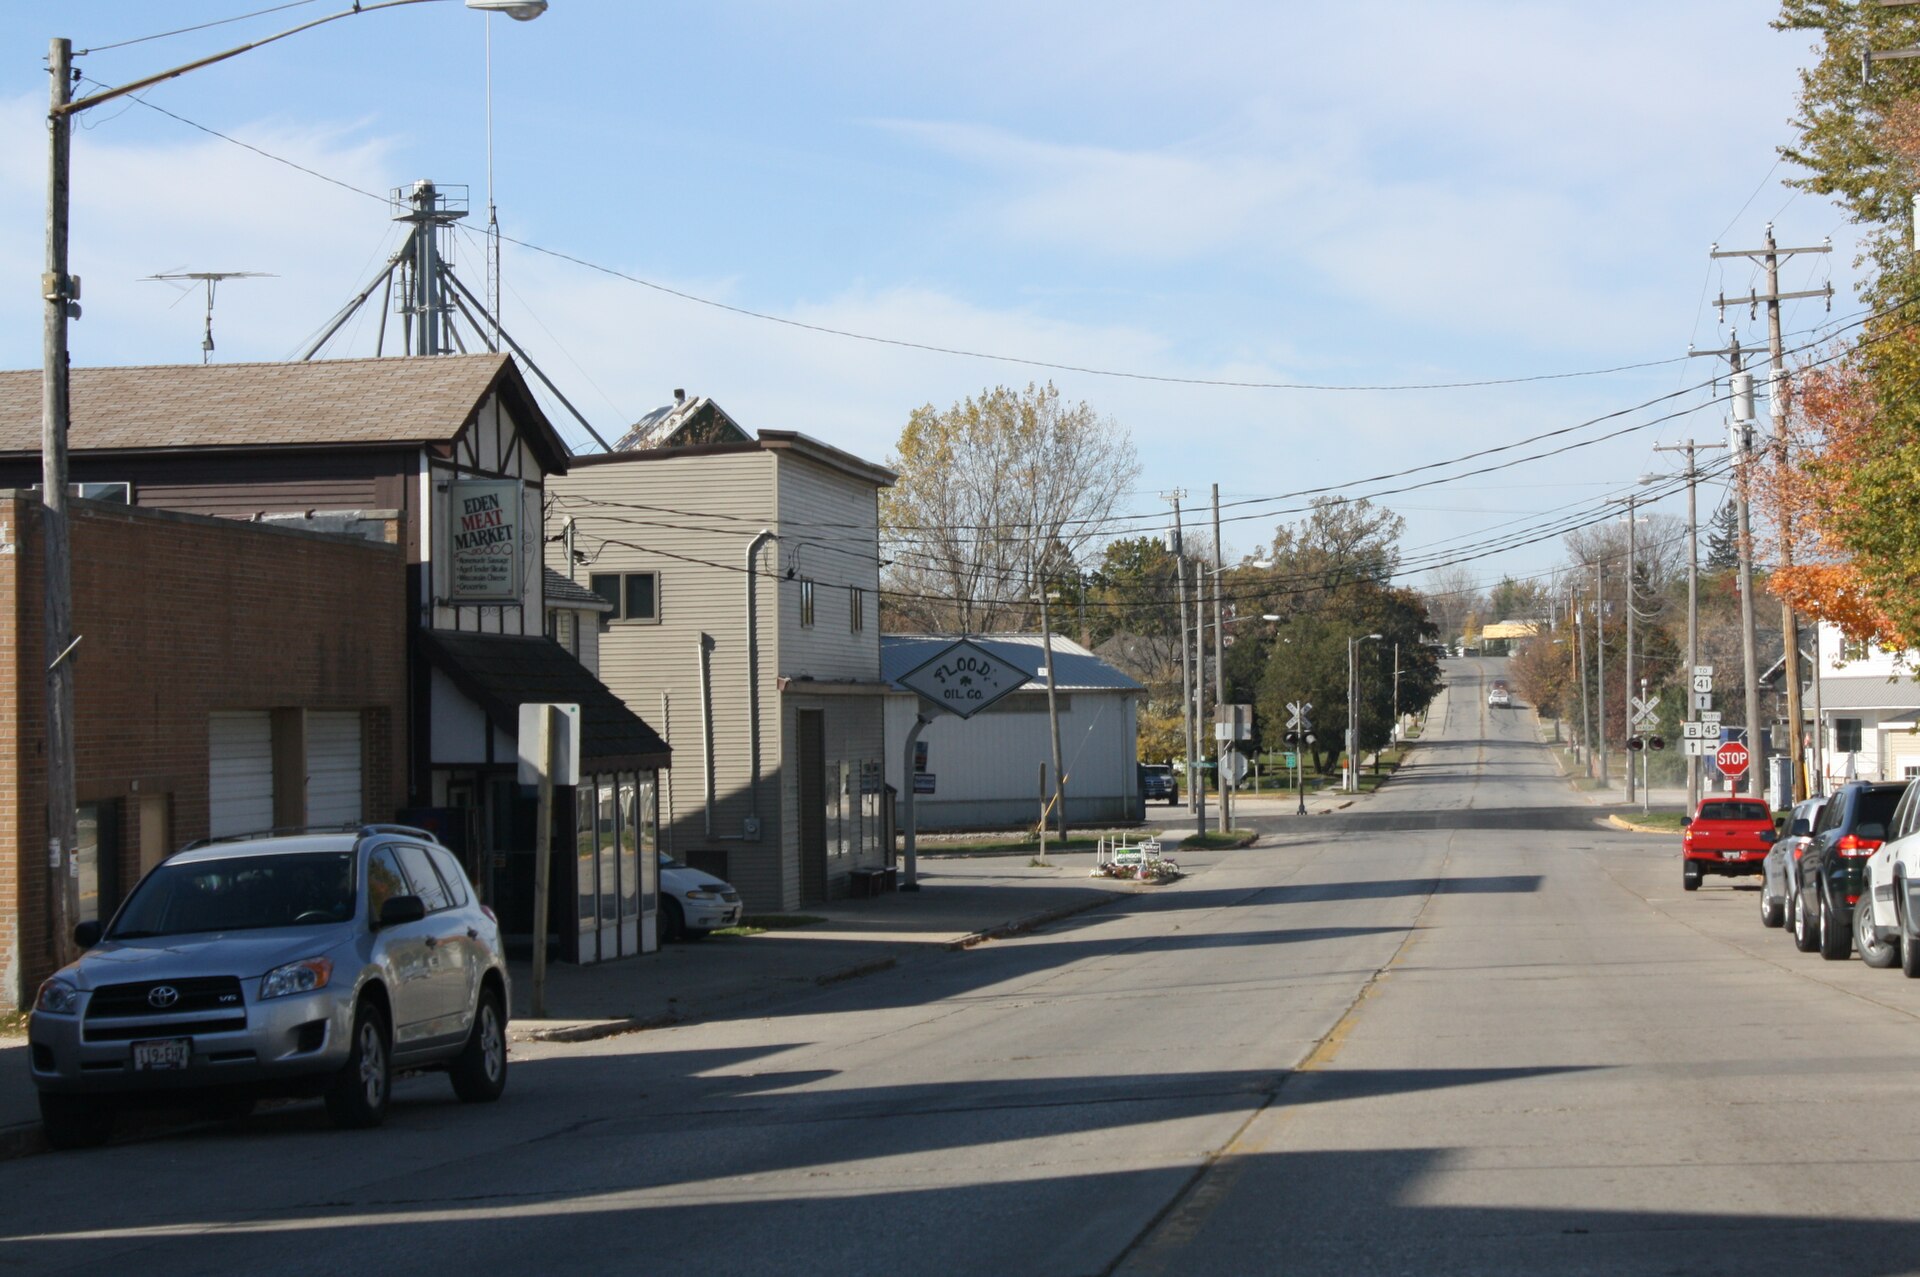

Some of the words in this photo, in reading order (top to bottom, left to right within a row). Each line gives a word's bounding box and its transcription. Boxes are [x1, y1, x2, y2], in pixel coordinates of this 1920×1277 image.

[463, 493, 499, 515] EDEN
[461, 509, 503, 532] MEAT
[454, 524, 513, 550] MARKET
[934, 657, 991, 684] FLOOD
[1696, 679, 1709, 689] 41
[1688, 727, 1697, 736] B
[1704, 725, 1718, 735] 45
[1718, 752, 1747, 765] STOP
